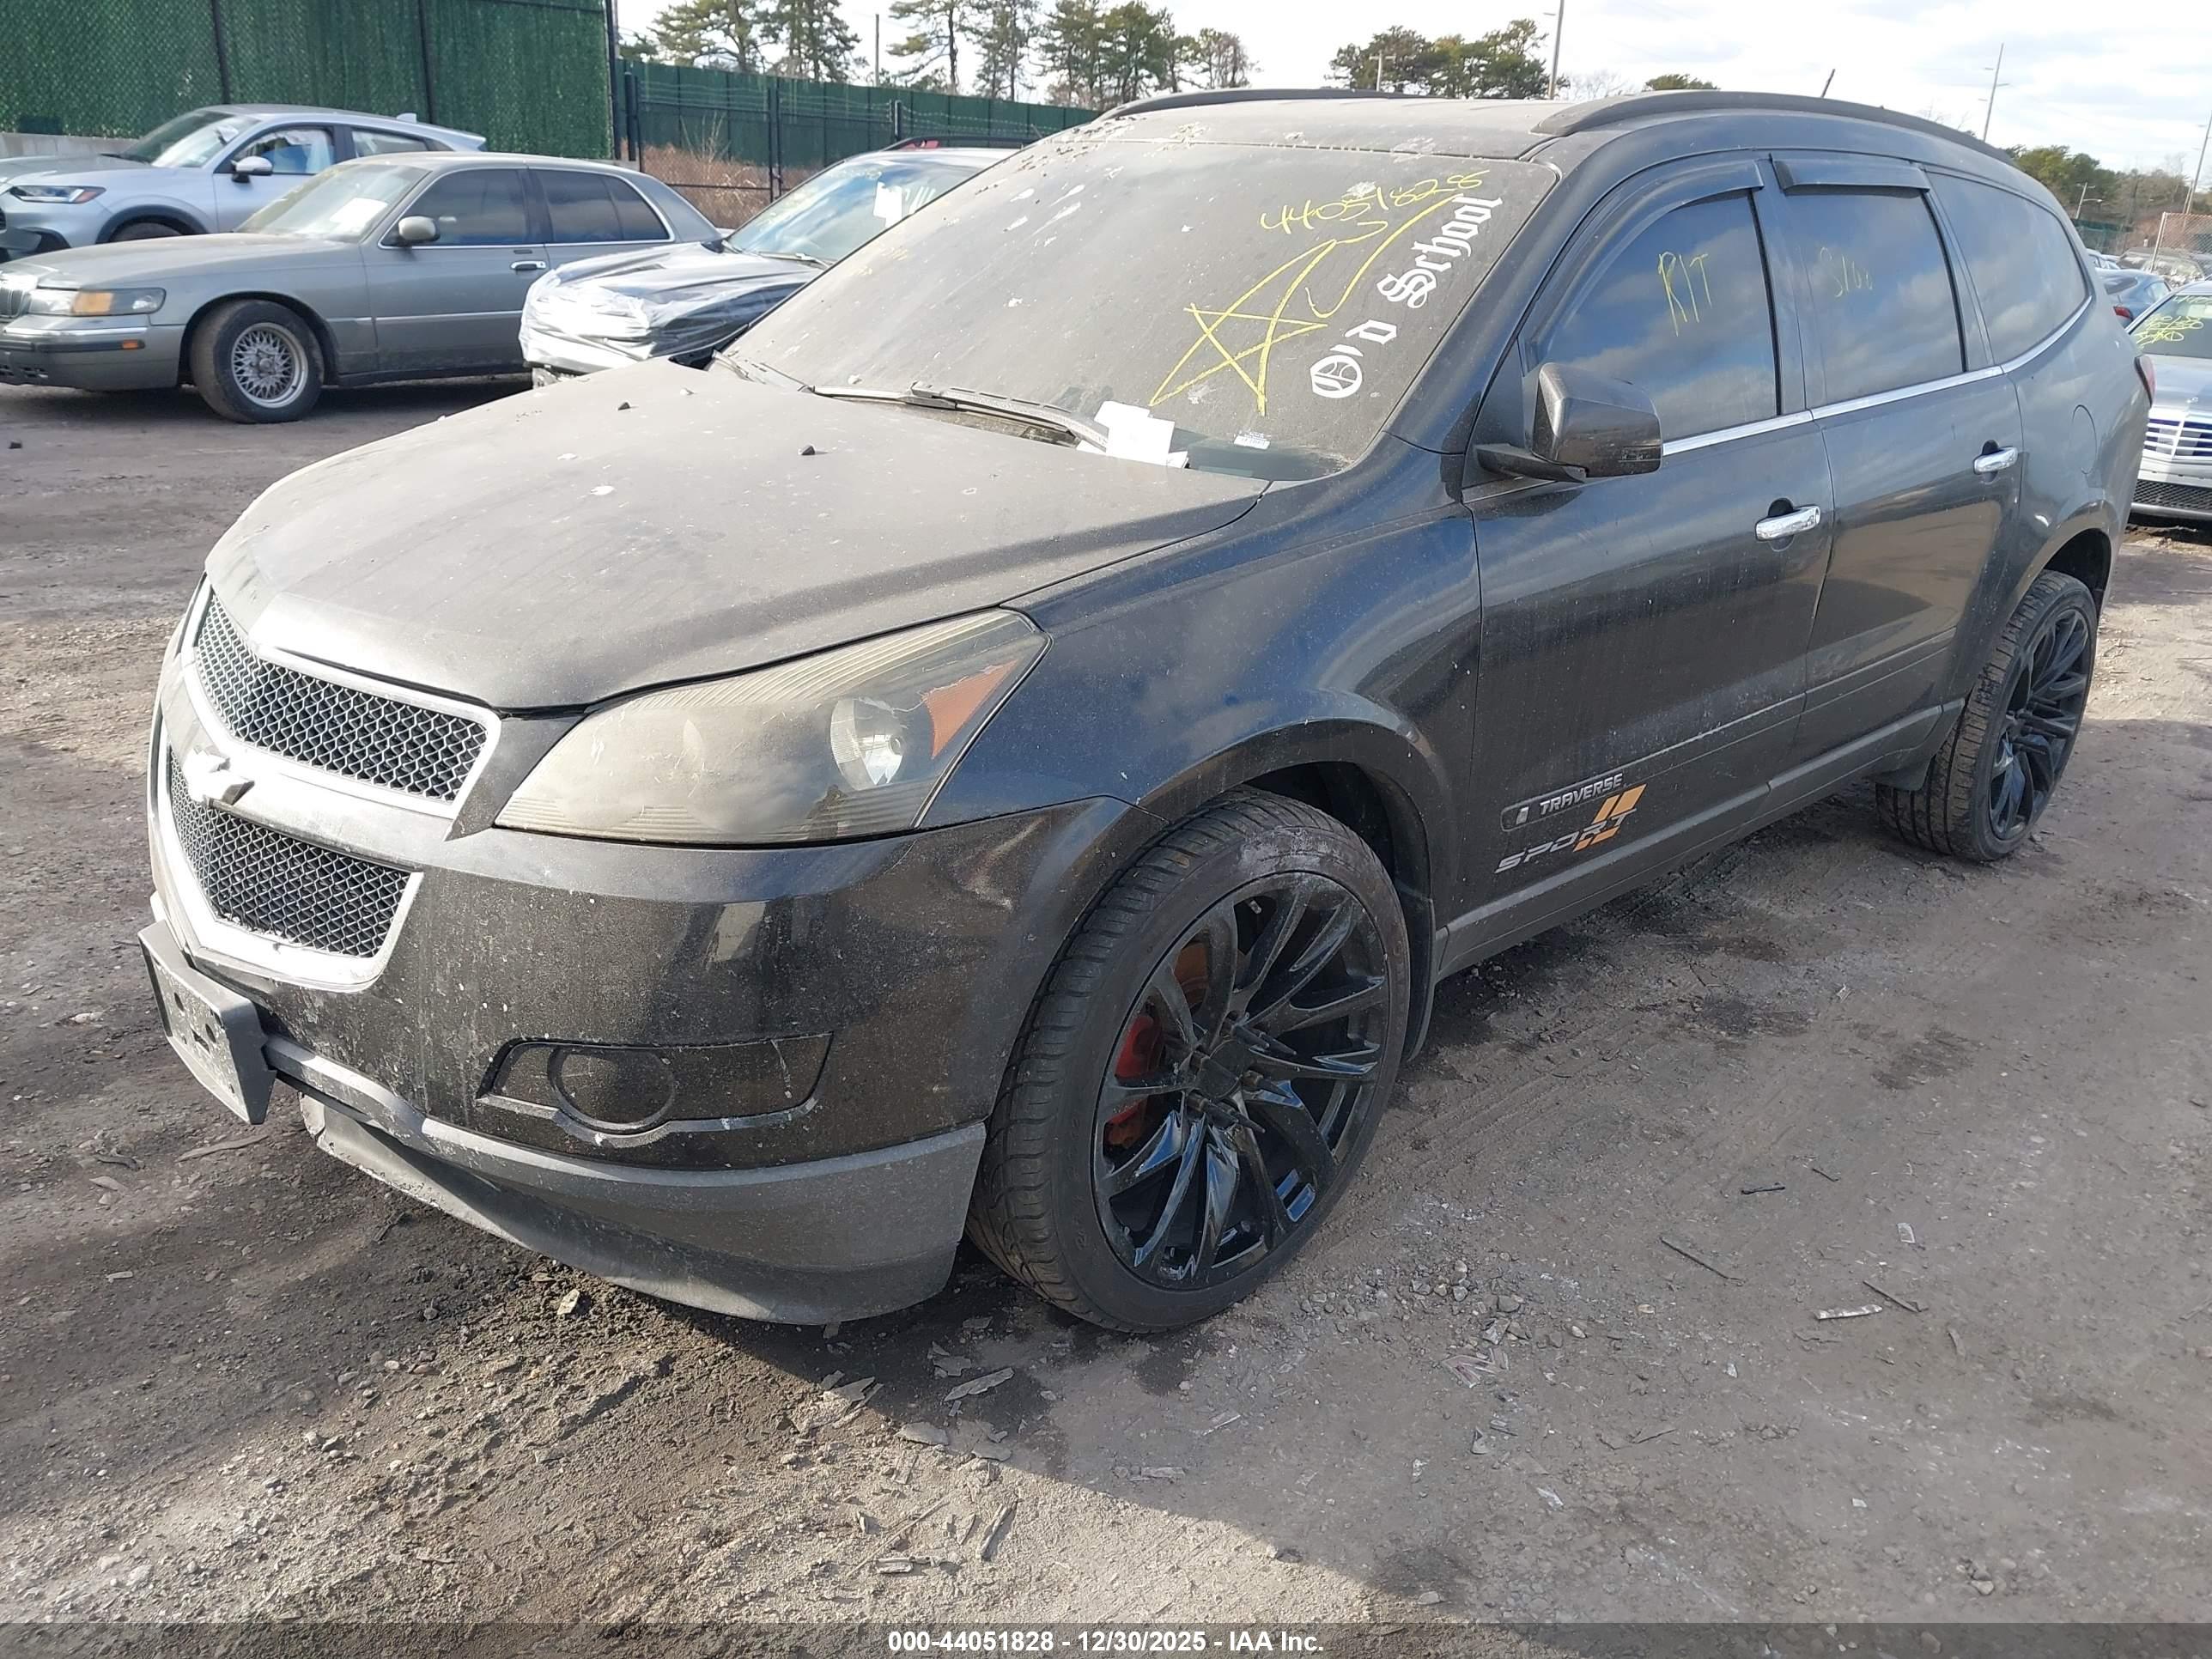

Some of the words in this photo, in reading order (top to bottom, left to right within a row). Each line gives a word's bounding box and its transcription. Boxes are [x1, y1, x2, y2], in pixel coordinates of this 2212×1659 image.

[1259, 169, 1491, 234] 44051828
[1376, 195, 1504, 309] School
[1539, 772, 1624, 816] TRAVERSE
[1493, 807, 1638, 874] SPORT
